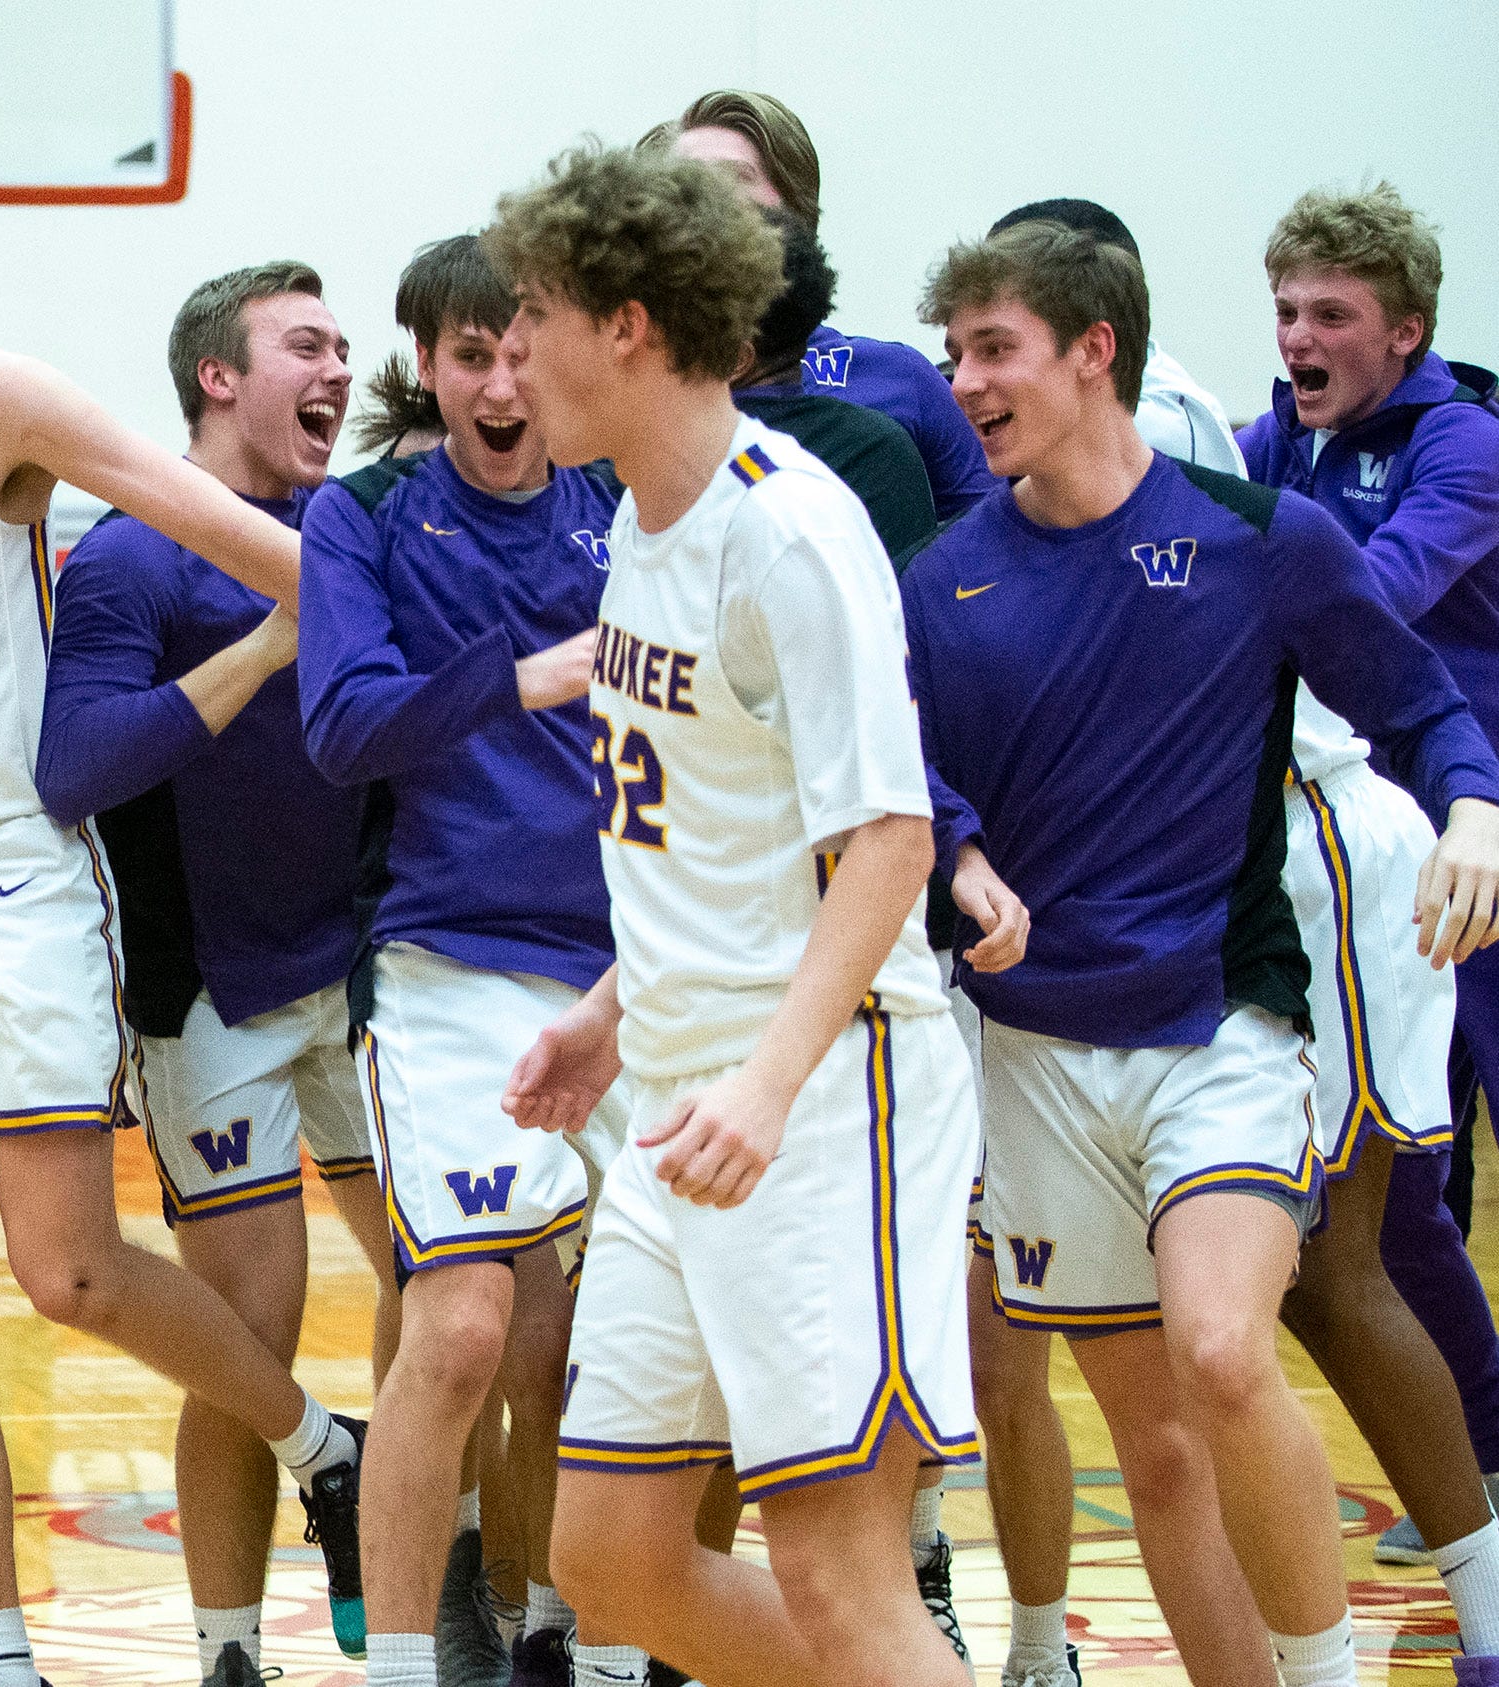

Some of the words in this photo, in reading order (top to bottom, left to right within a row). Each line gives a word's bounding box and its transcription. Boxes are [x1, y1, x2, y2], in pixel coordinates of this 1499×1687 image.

[1130, 537, 1197, 587] W
[187, 1116, 253, 1179] W
[441, 1162, 522, 1222] W
[1005, 1233, 1057, 1292] W
